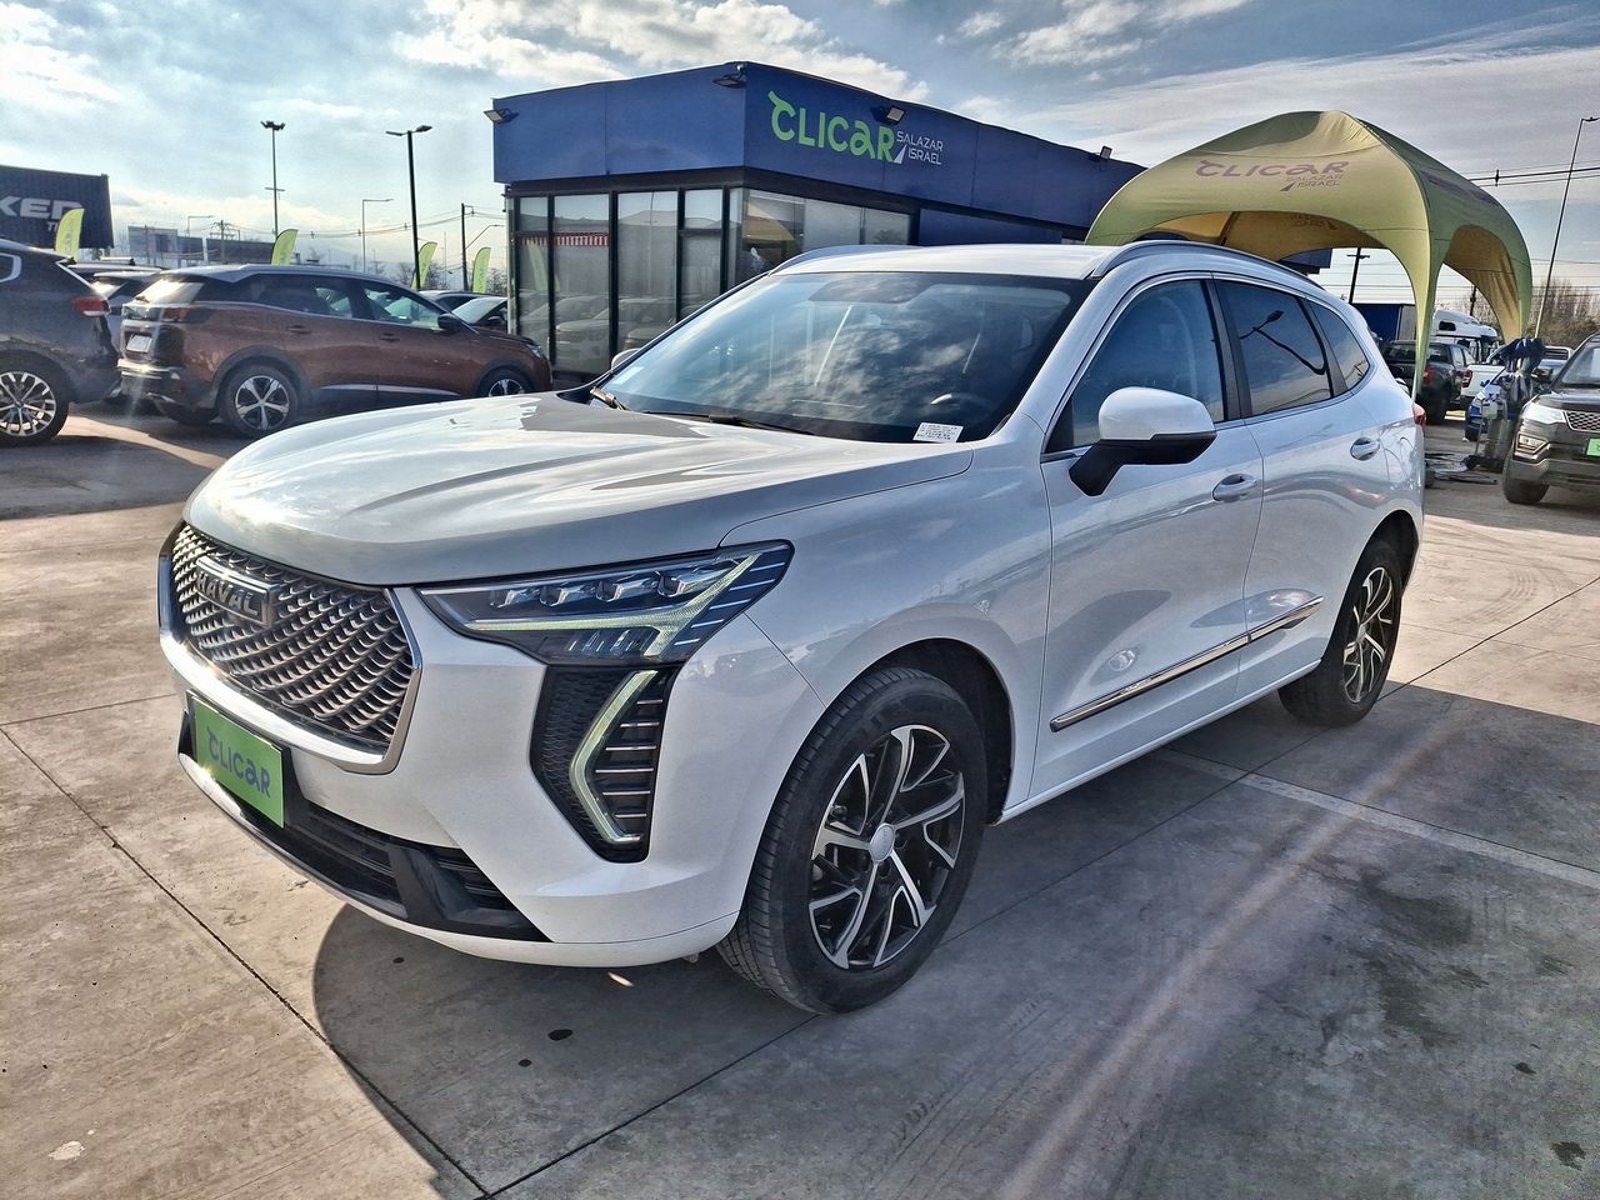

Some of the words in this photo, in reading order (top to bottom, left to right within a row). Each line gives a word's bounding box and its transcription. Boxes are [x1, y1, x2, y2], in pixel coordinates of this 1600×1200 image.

[896, 130, 943, 152] SALAZAR
[908, 148, 942, 165] ISRAEL
[196, 571, 259, 615] HAVAL
